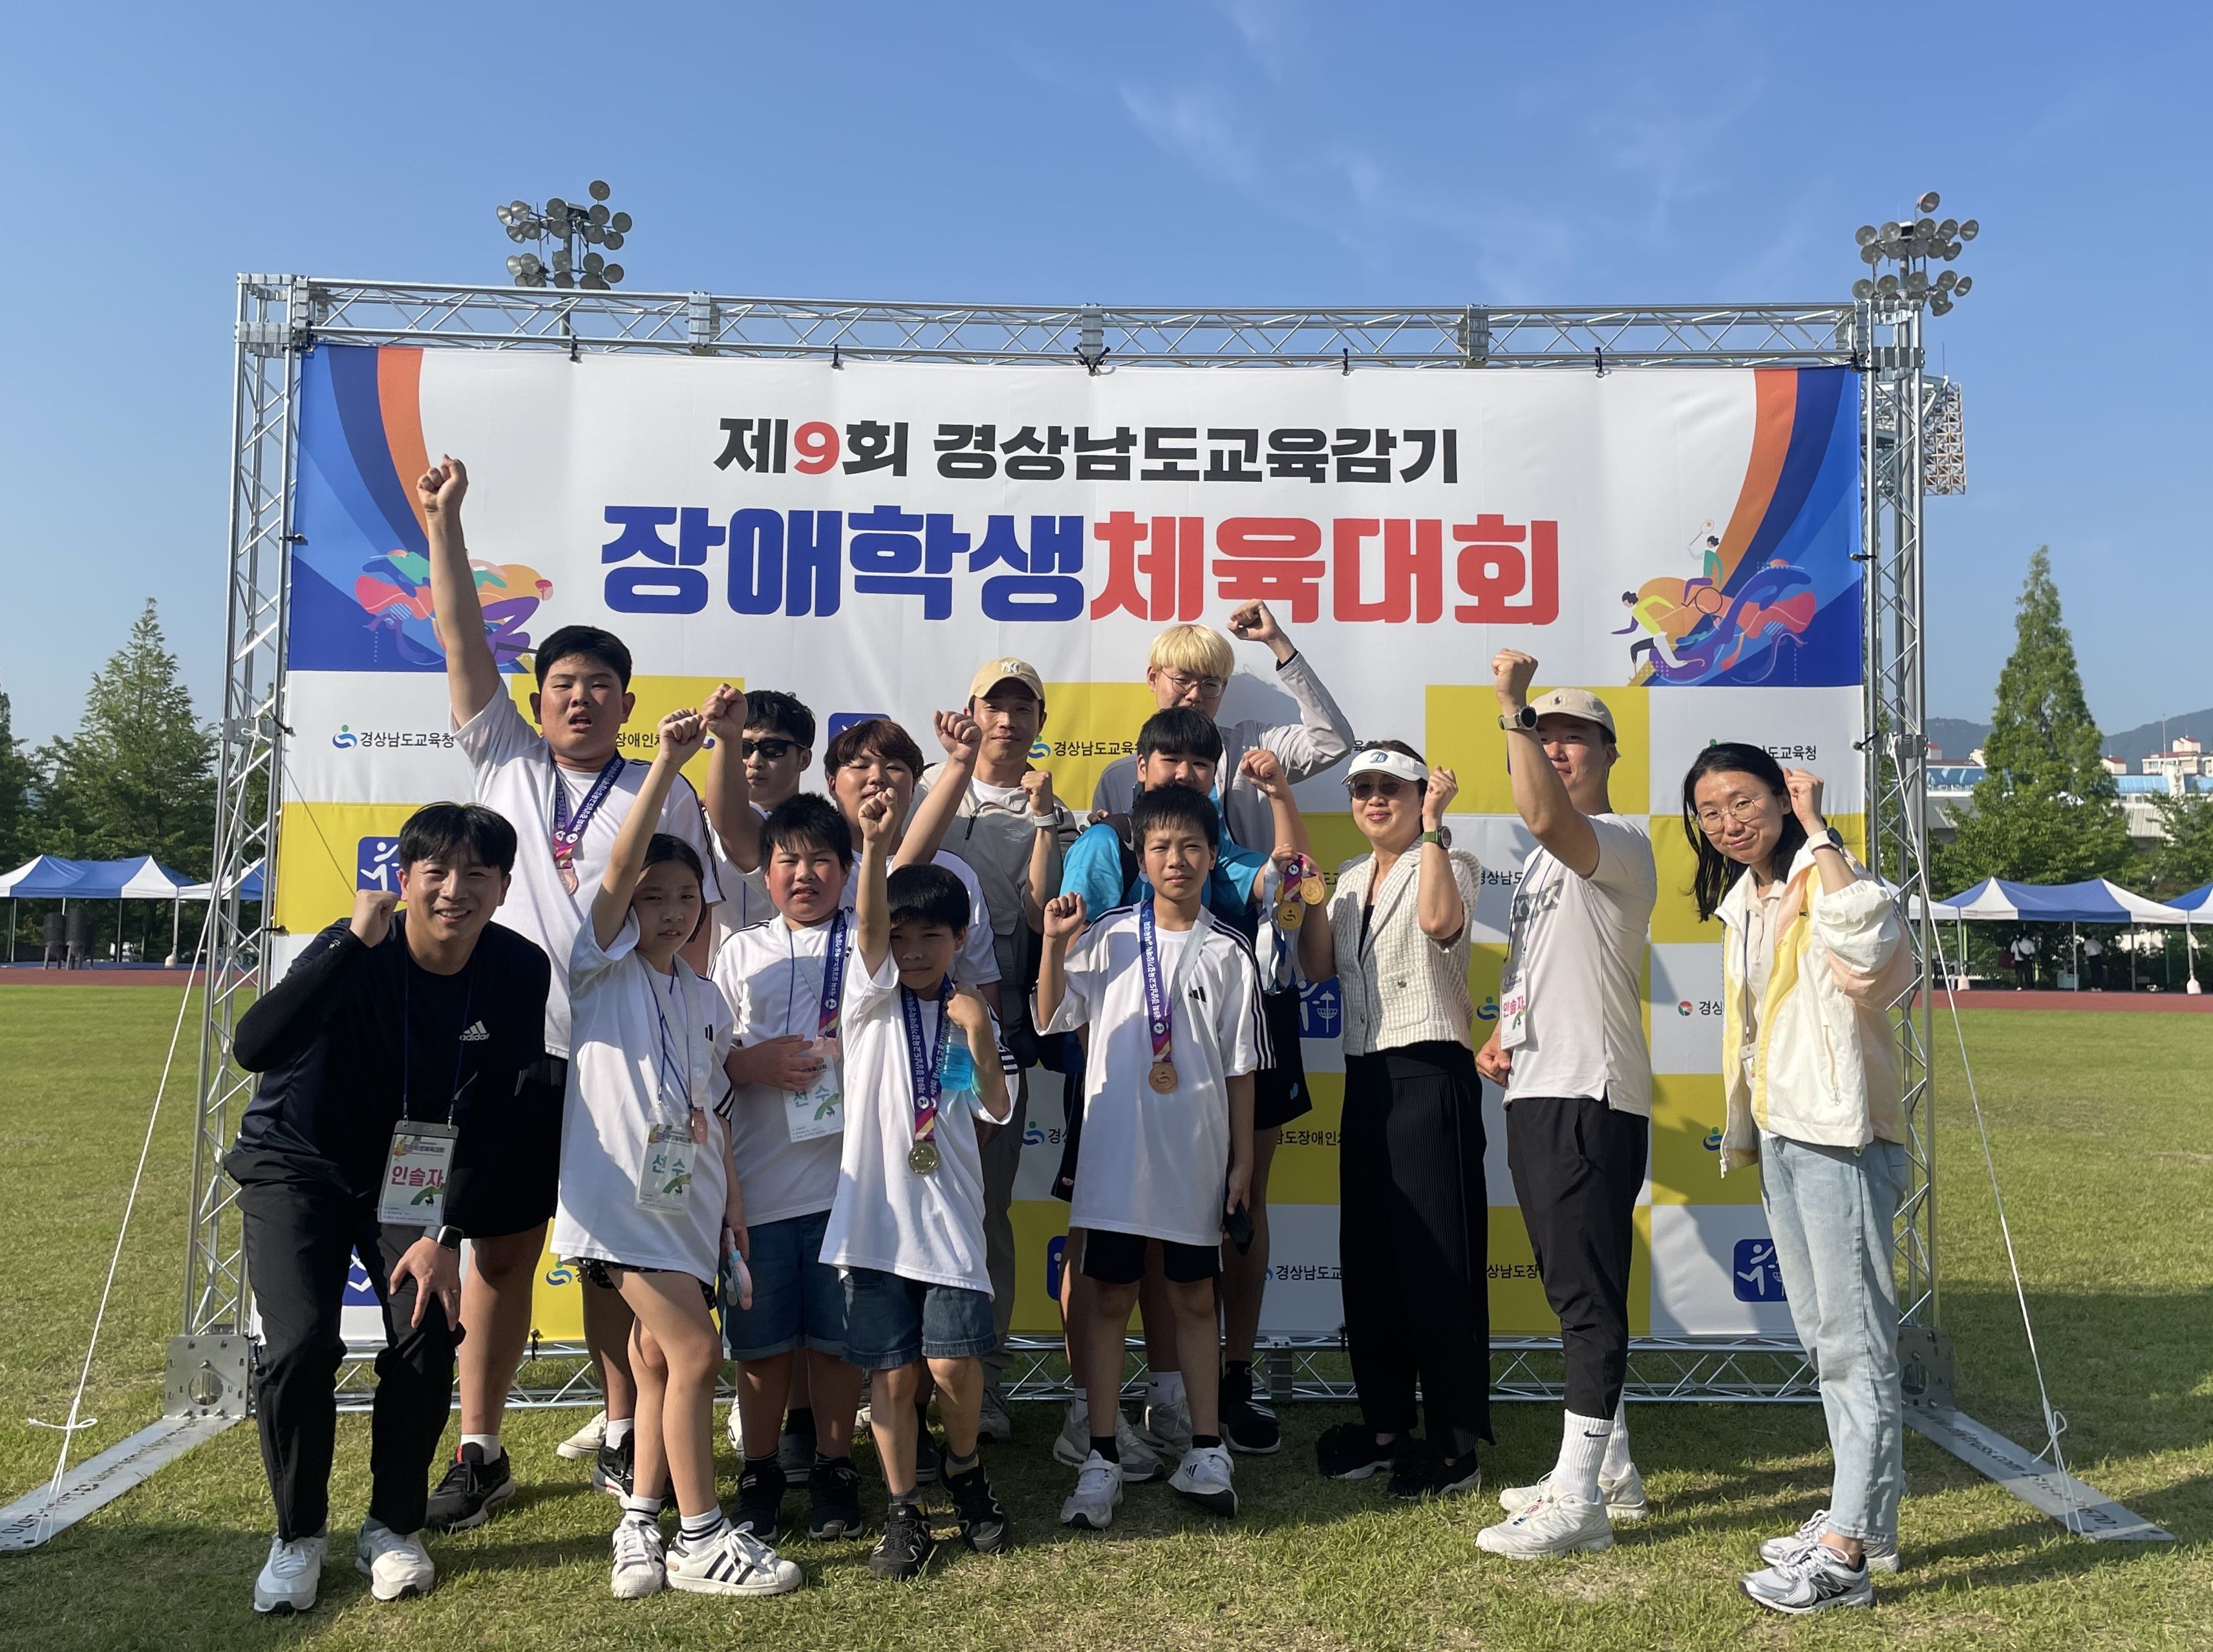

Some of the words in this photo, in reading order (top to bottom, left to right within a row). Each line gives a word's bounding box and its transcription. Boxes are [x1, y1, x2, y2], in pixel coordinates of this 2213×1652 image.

[714, 417, 909, 478] 제9회
[934, 424, 1458, 484] 경상남도교육감기
[600, 504, 1559, 626] 장애학생체육대회
[360, 731, 454, 748] 경상남도교육청
[1054, 740, 1138, 756] 경상남도교육
[1503, 995, 1524, 1018] 인솔자
[391, 1165, 444, 1190] 인솔자
